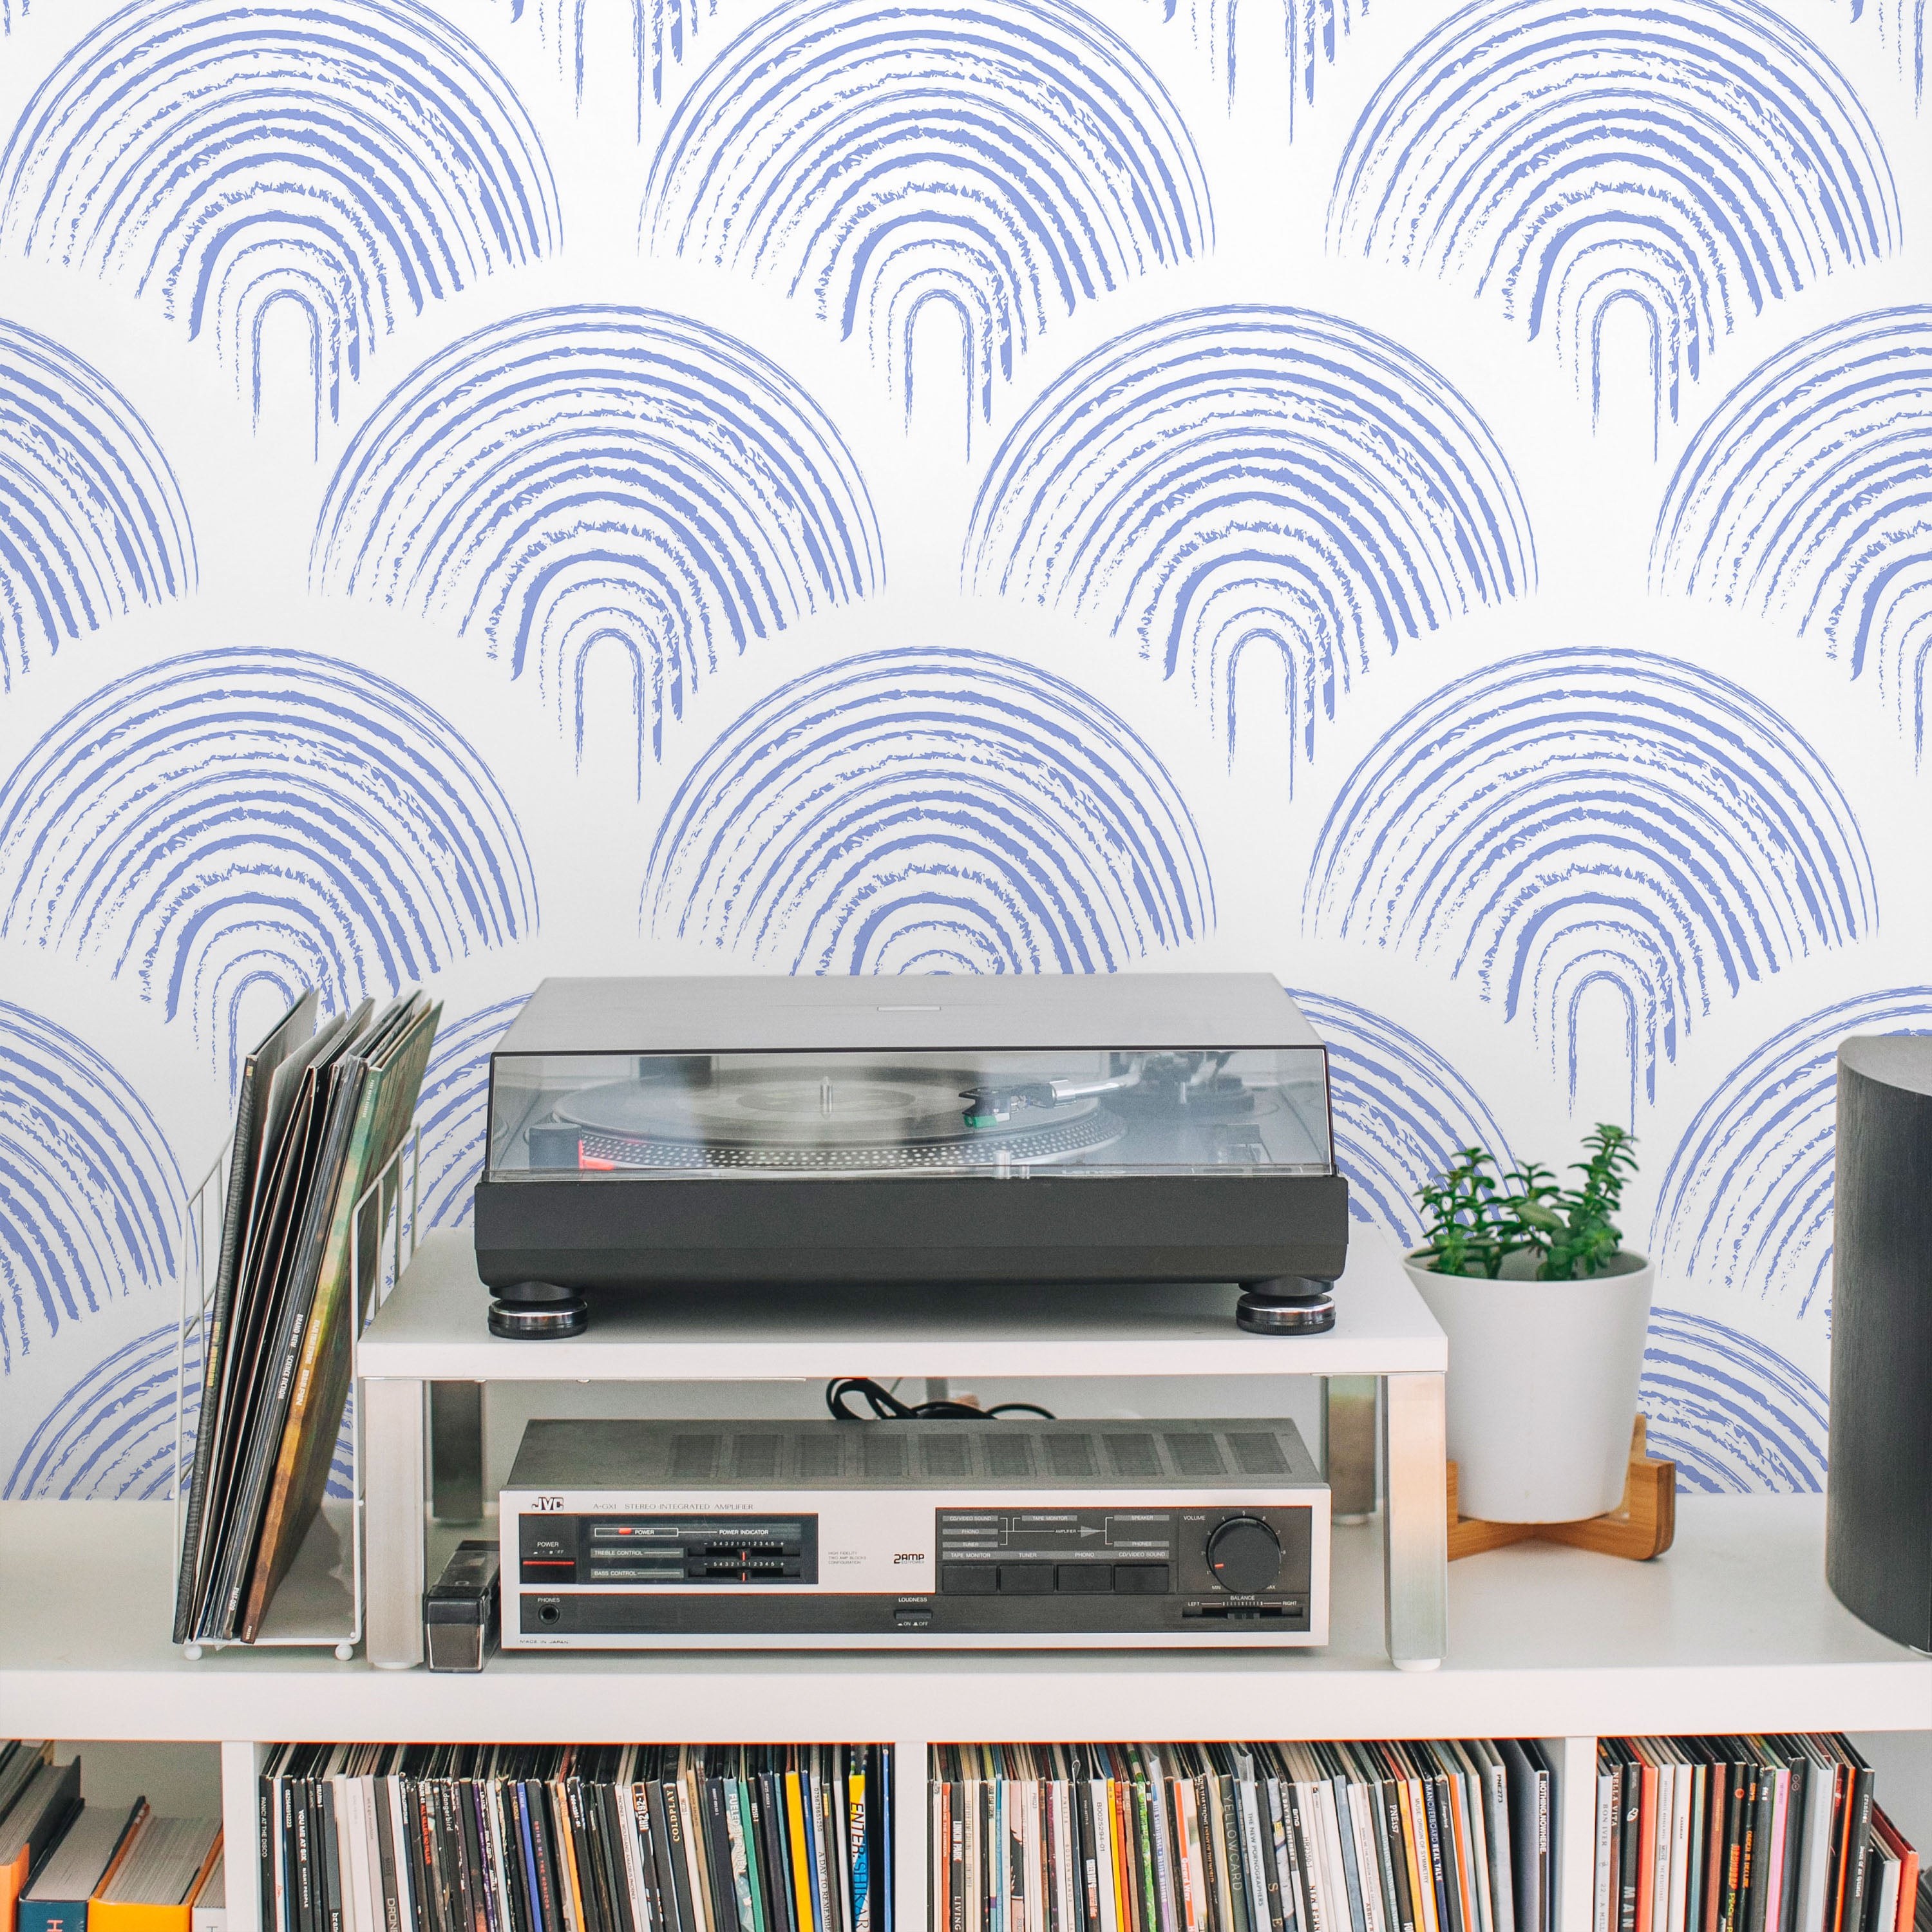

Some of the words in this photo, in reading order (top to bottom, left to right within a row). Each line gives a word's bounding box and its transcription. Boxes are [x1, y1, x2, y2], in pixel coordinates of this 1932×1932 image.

[294, 1314, 303, 1333] BRAND
[290, 1333, 299, 1347] NEW
[283, 1355, 294, 1377] SCIENCE
[278, 1377, 289, 1399] FICTION
[531, 1497, 564, 1510] JVC
[443, 1793, 453, 1832] dangerbird
[667, 1790, 679, 1843] COLDPLAY
[728, 1794, 741, 1825] FUELED
[943, 1812, 947, 1821] ME
[1285, 1815, 1291, 1823] TO
[1389, 1804, 1399, 1833] PNE157
[299, 1826, 305, 1837] ME
[621, 1824, 630, 1852] WOLFGANG
[952, 1821, 962, 1842] LINKIN
[1096, 1802, 1105, 1852] B0025294-01
[300, 1838, 306, 1848] AT
[953, 1843, 962, 1861] PARK
[1223, 1794, 1242, 1891] YELLOWCARD
[1287, 1826, 1295, 1861] REMEMBER
[1303, 1837, 1312, 1869] HR2350-1
[1419, 1841, 1425, 1849] OF
[1432, 1844, 1441, 1861] REAL
[733, 1840, 746, 1872] RAMEN
[536, 1846, 542, 1857] ME
[540, 1877, 550, 1909] HORIZON
[1182, 1857, 1191, 1883] Gerard
[1251, 1846, 1264, 1906] PORNOGRAPHERS
[1420, 1851, 1428, 1884] SYMMETRY
[1434, 1863, 1443, 1881] TALK
[821, 1879, 828, 1888] TO
